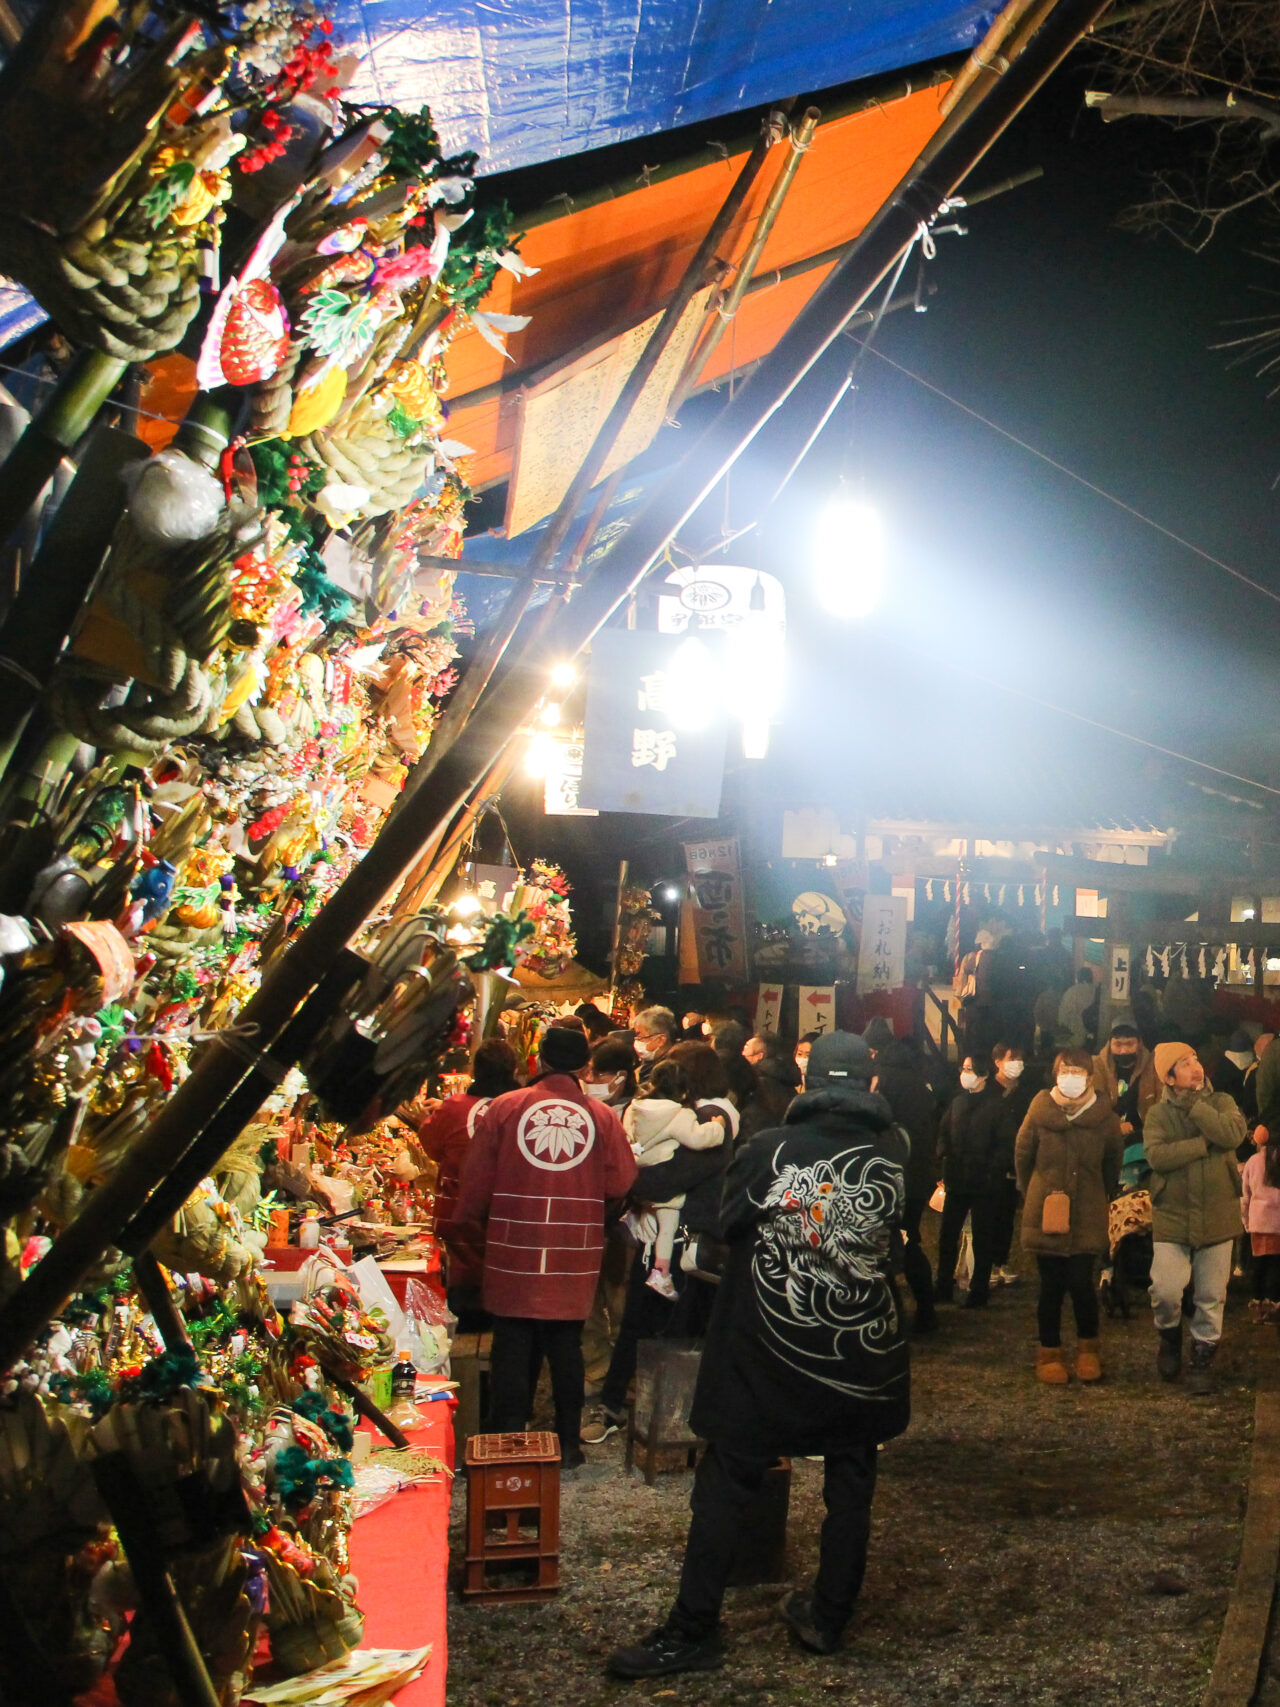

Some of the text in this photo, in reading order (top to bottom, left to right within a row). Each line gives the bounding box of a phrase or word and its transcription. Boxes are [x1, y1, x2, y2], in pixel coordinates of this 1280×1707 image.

[478, 880, 496, 899] 高
[1113, 954, 1128, 992] 上り
[762, 1009, 773, 1031] トイ
[814, 1012, 828, 1034] トイ
